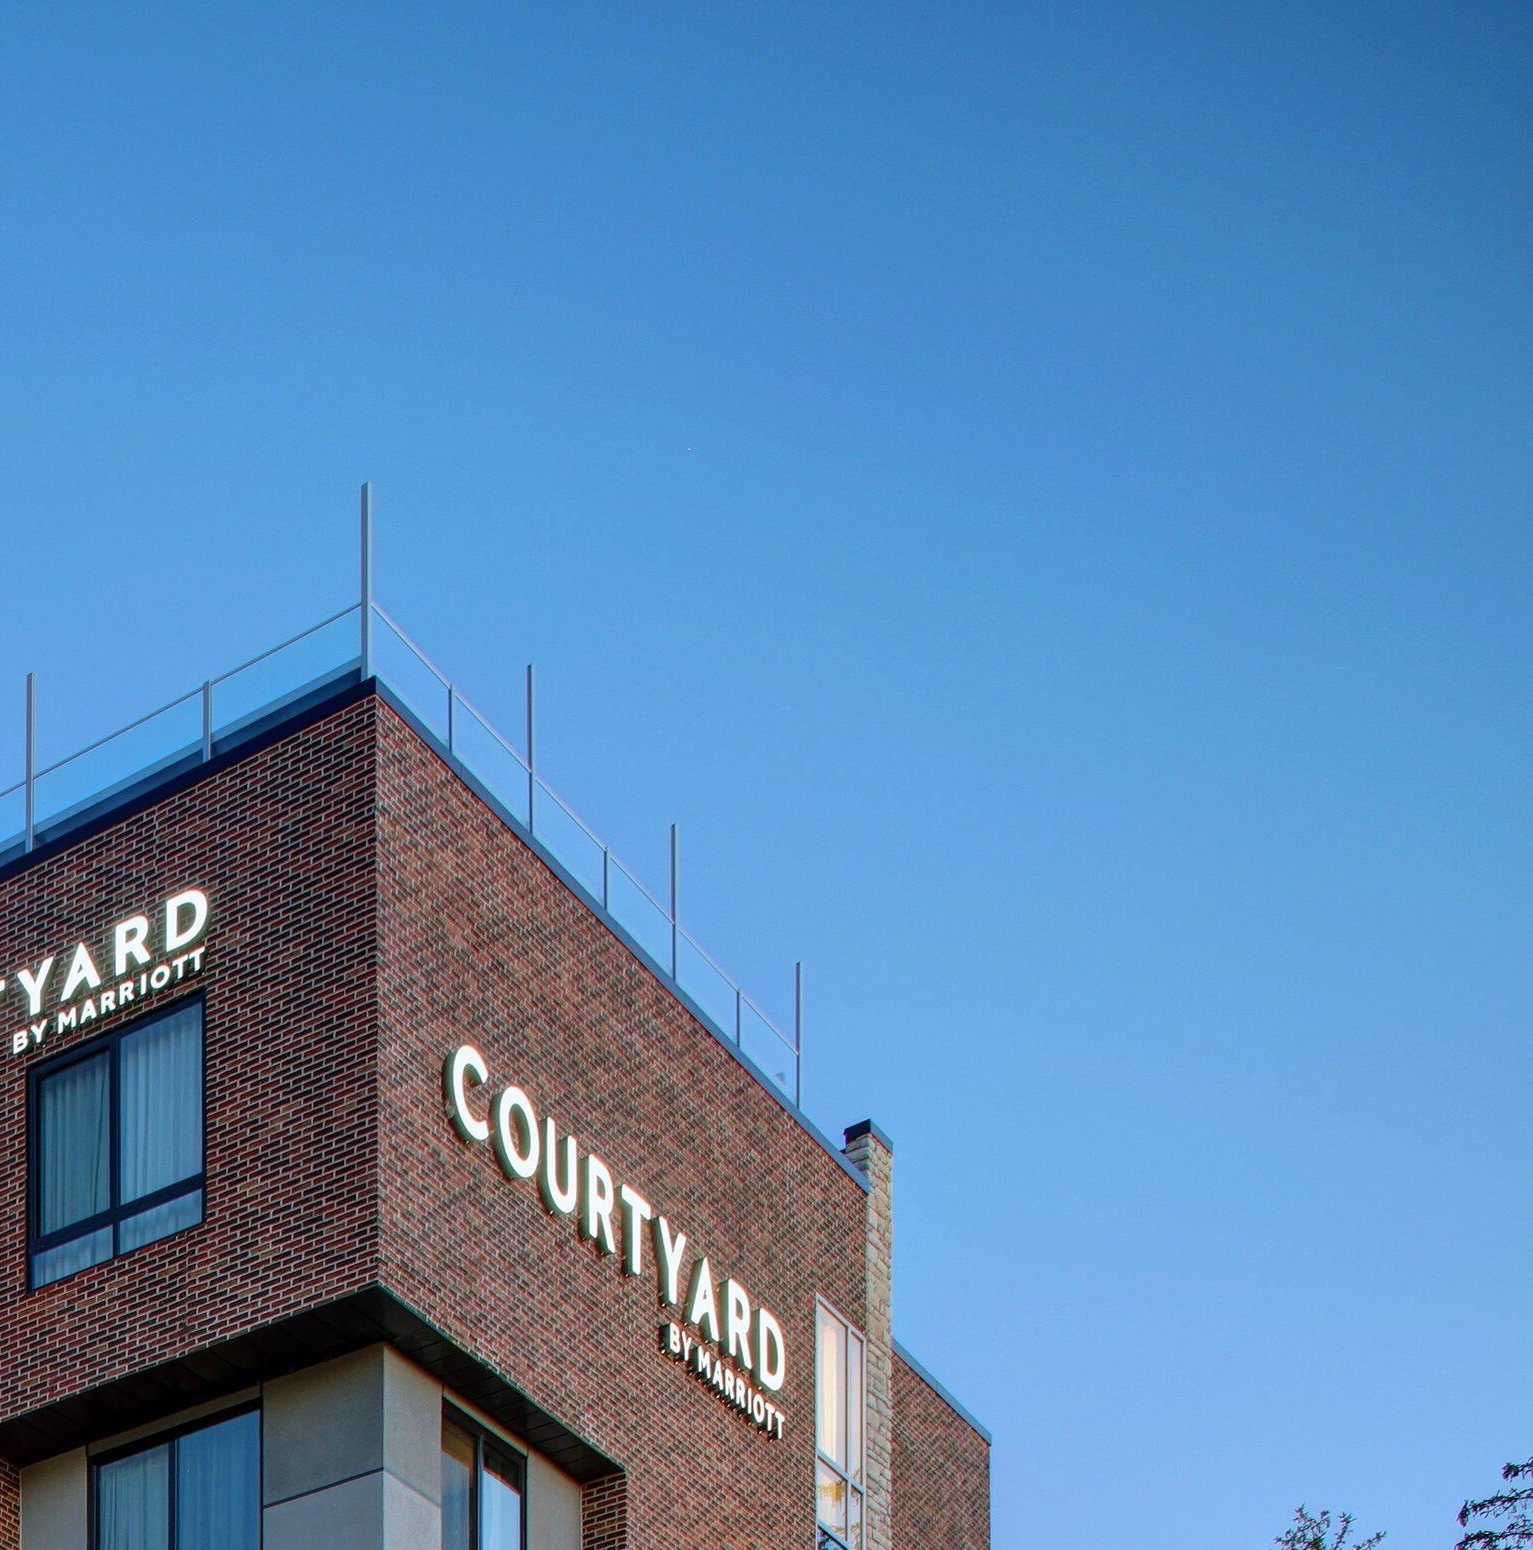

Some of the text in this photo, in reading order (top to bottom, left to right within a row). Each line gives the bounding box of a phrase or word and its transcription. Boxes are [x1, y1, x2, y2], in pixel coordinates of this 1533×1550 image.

[12, 945, 206, 1055] BY MARRIOTT
[450, 1043, 787, 1392] COURTYARD
[668, 1321, 787, 1441] BY MARRIOTT
